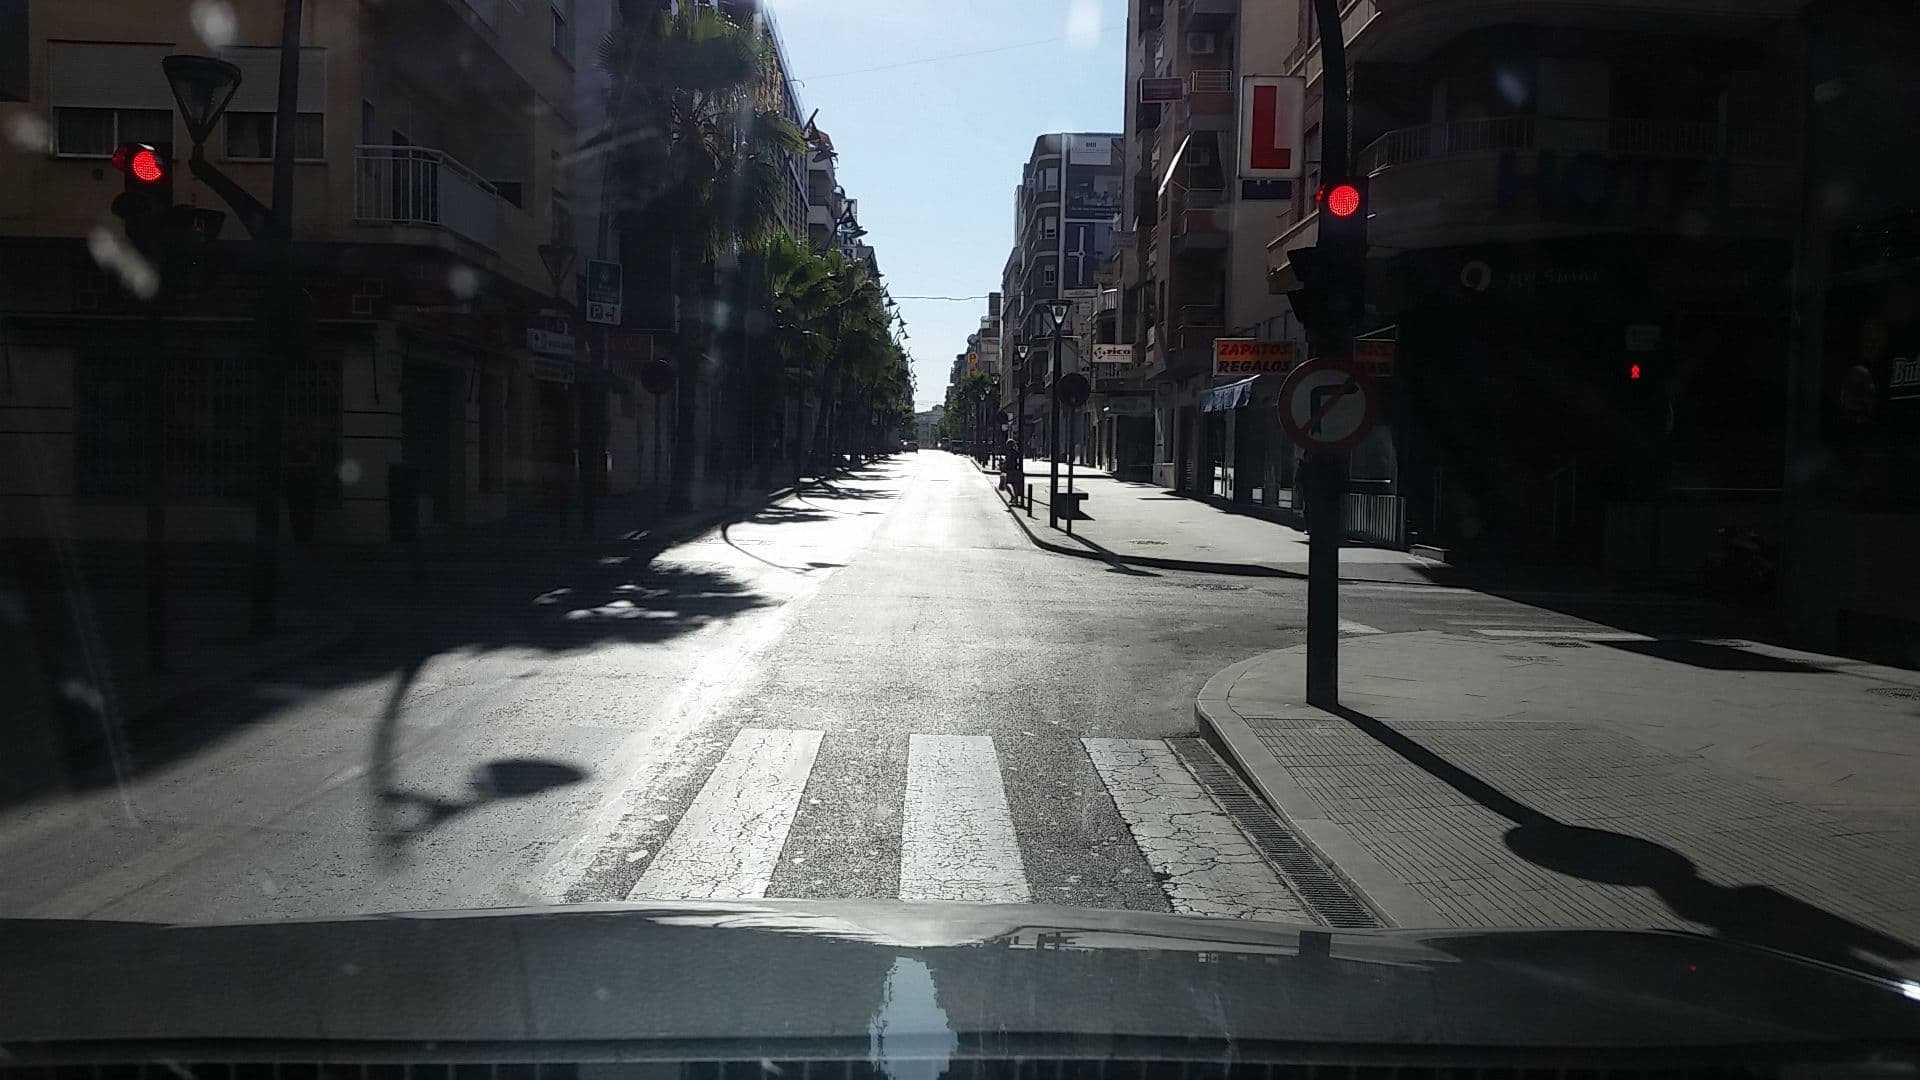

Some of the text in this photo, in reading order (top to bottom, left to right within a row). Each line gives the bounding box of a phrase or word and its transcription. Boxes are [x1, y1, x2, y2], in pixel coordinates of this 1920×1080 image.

[1251, 86, 1291, 168] L
[1496, 150, 1735, 210] HOTEL
[1218, 361, 1292, 373] REGALOS
[1219, 343, 1291, 356] ZAPATOS
